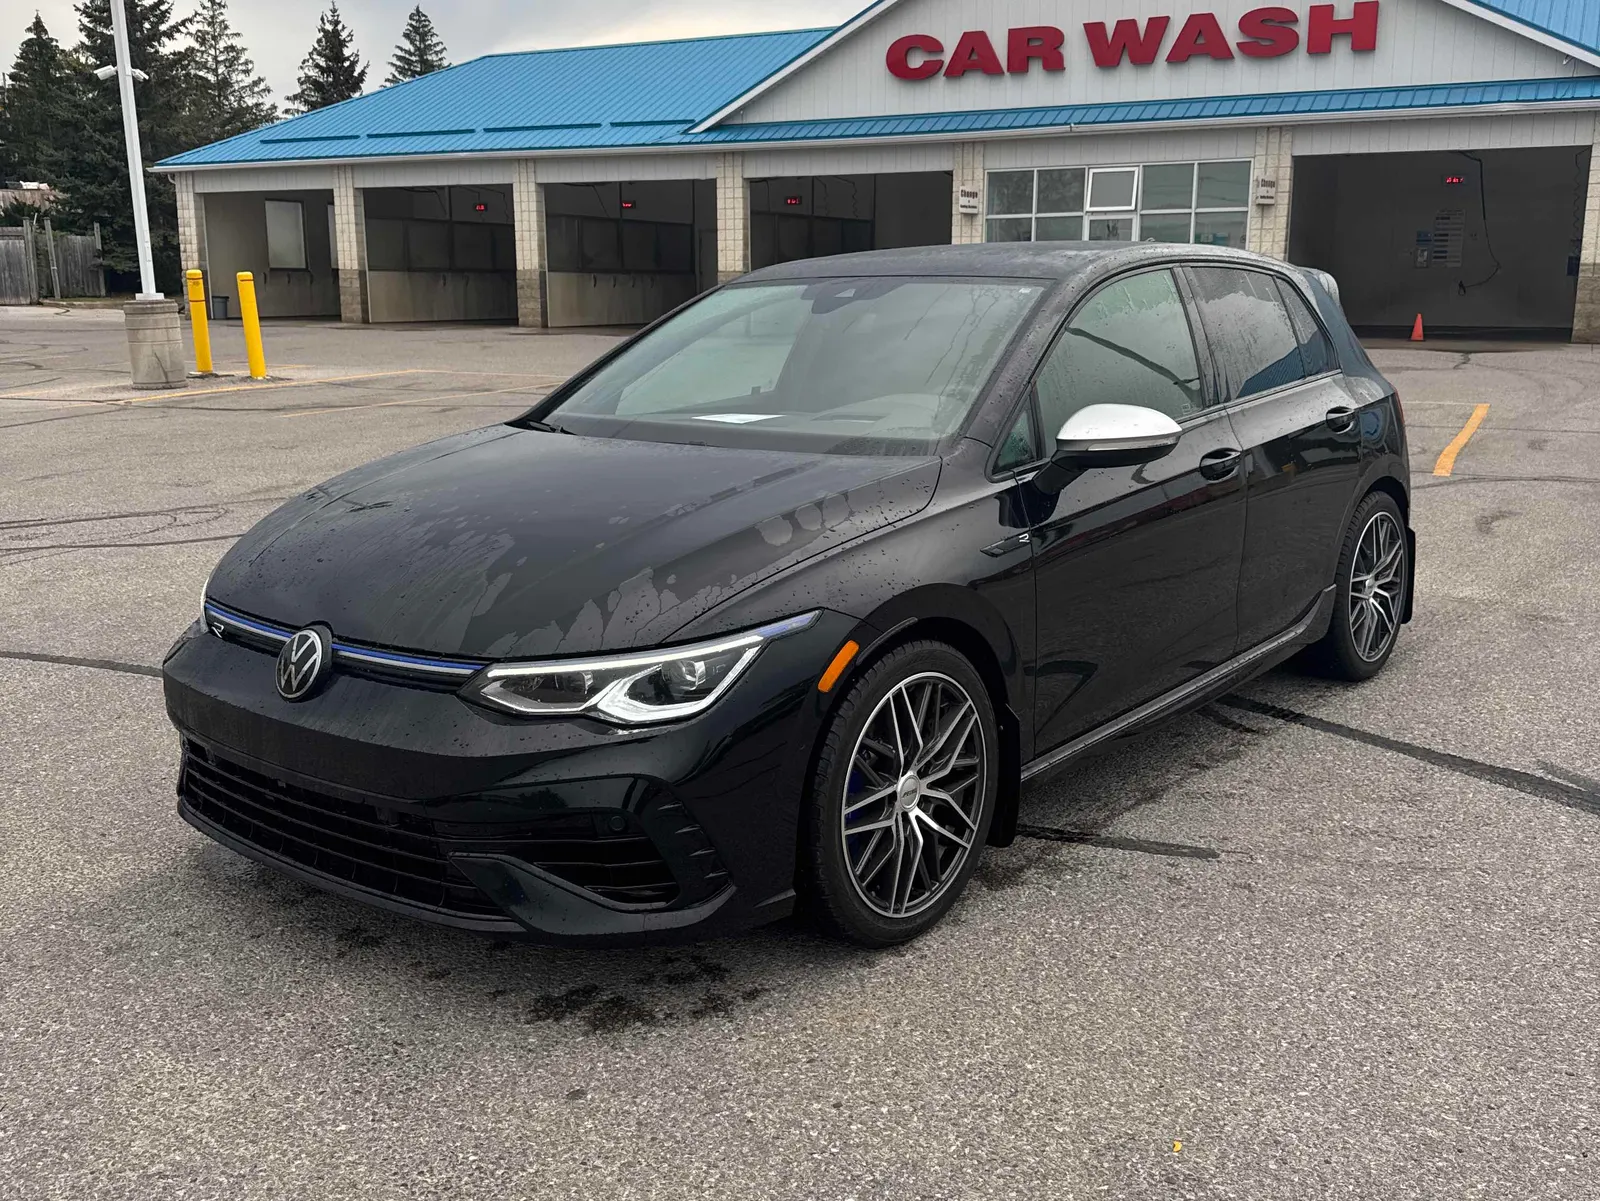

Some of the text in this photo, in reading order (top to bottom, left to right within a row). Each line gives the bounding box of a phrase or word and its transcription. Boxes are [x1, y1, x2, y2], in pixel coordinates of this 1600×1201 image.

[886, 1, 1379, 81] CAR WASH
[961, 189, 978, 200] Change
[211, 621, 225, 638] R
